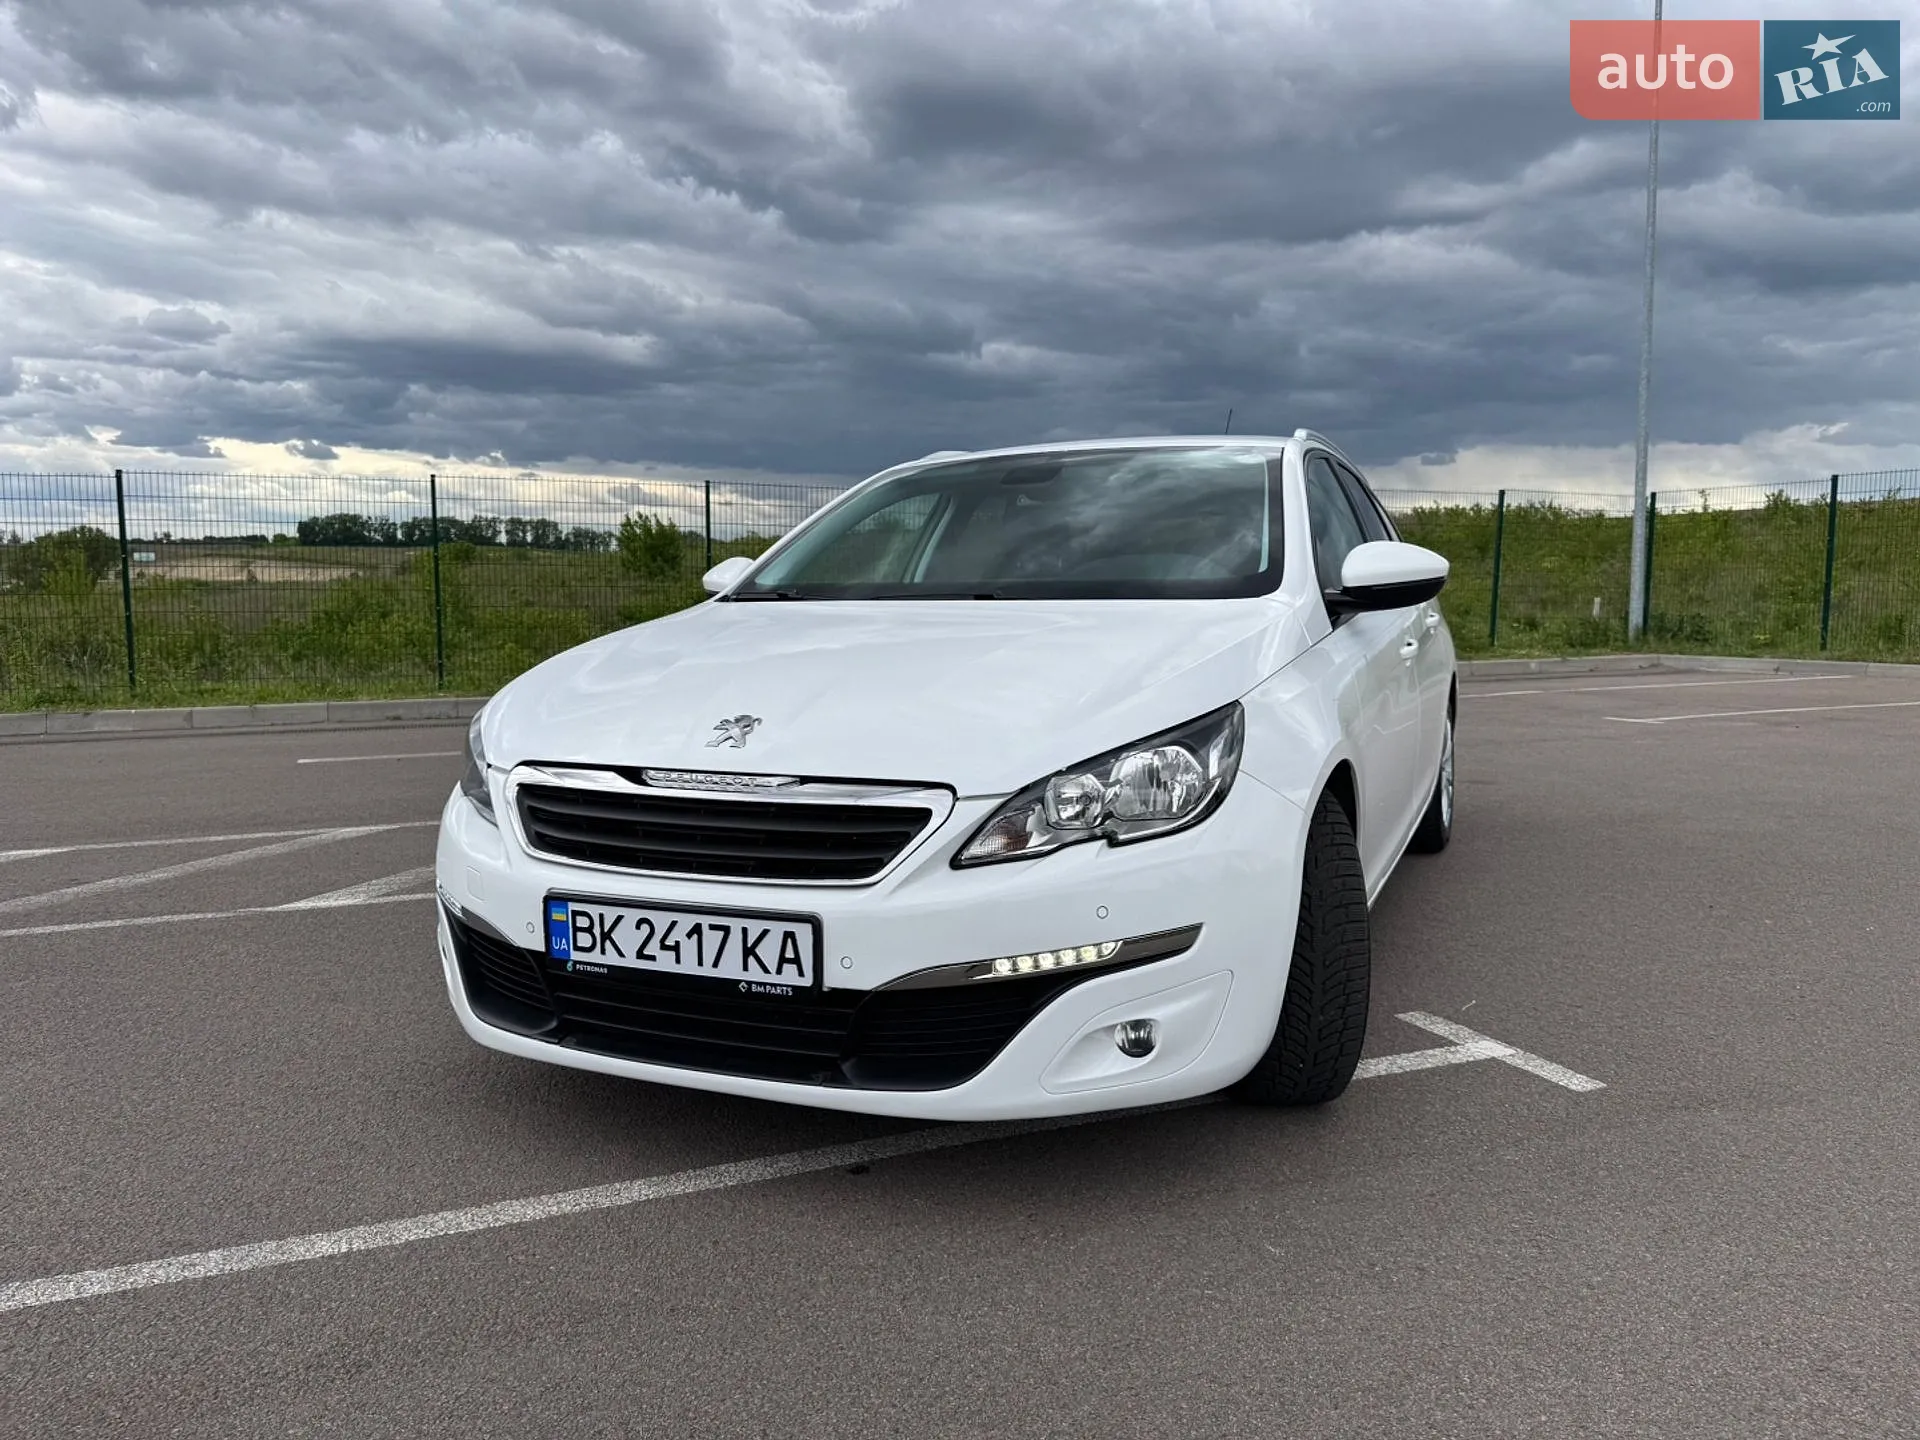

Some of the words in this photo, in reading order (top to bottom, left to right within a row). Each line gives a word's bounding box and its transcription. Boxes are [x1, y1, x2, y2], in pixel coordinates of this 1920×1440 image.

[664, 773, 757, 787] PEUGEOT
[552, 936, 568, 951] UA
[571, 910, 625, 958] BK
[635, 917, 731, 969] 2417
[741, 926, 805, 978] KA
